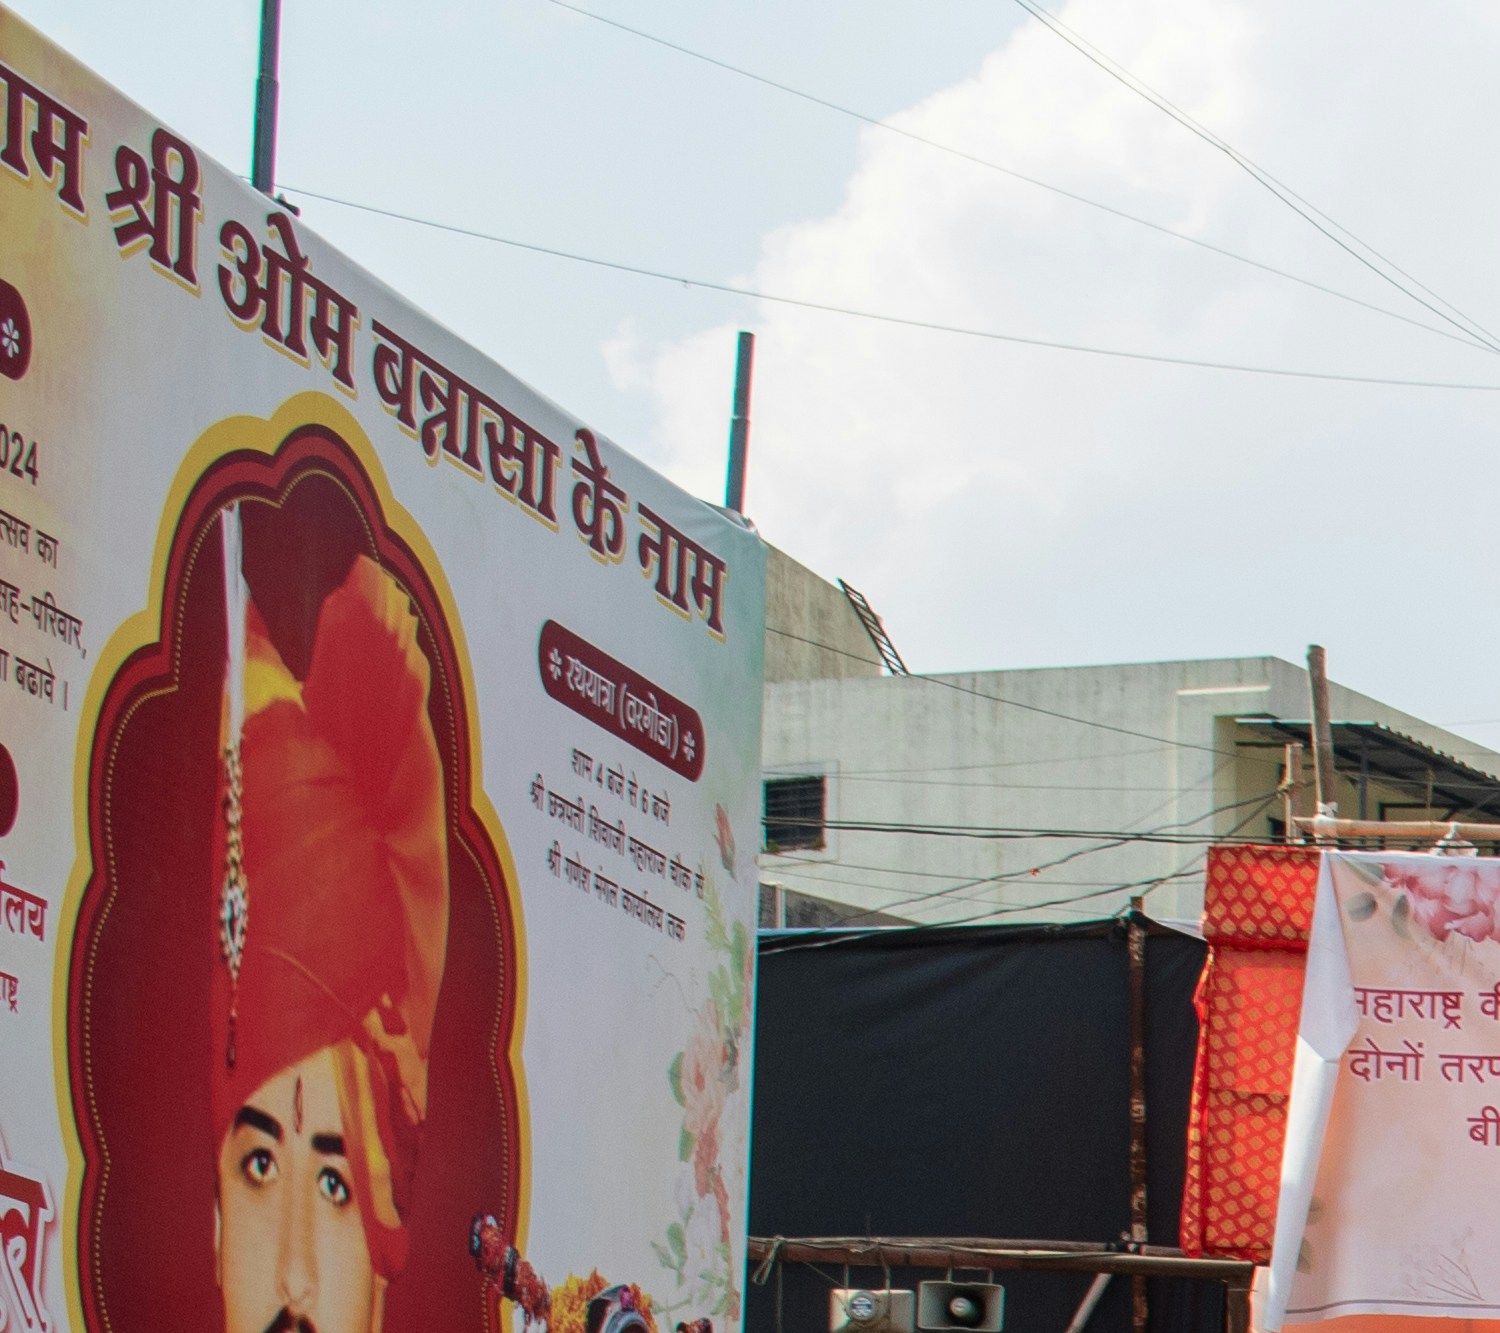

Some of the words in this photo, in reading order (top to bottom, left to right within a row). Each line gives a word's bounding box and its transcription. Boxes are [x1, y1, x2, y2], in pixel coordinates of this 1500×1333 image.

[105, 128, 201, 288] श्री
[216, 212, 357, 394] ओम
[571, 427, 626, 559] के
[636, 503, 726, 637] नाम
[1349, 1041, 1422, 1085] दोनों
